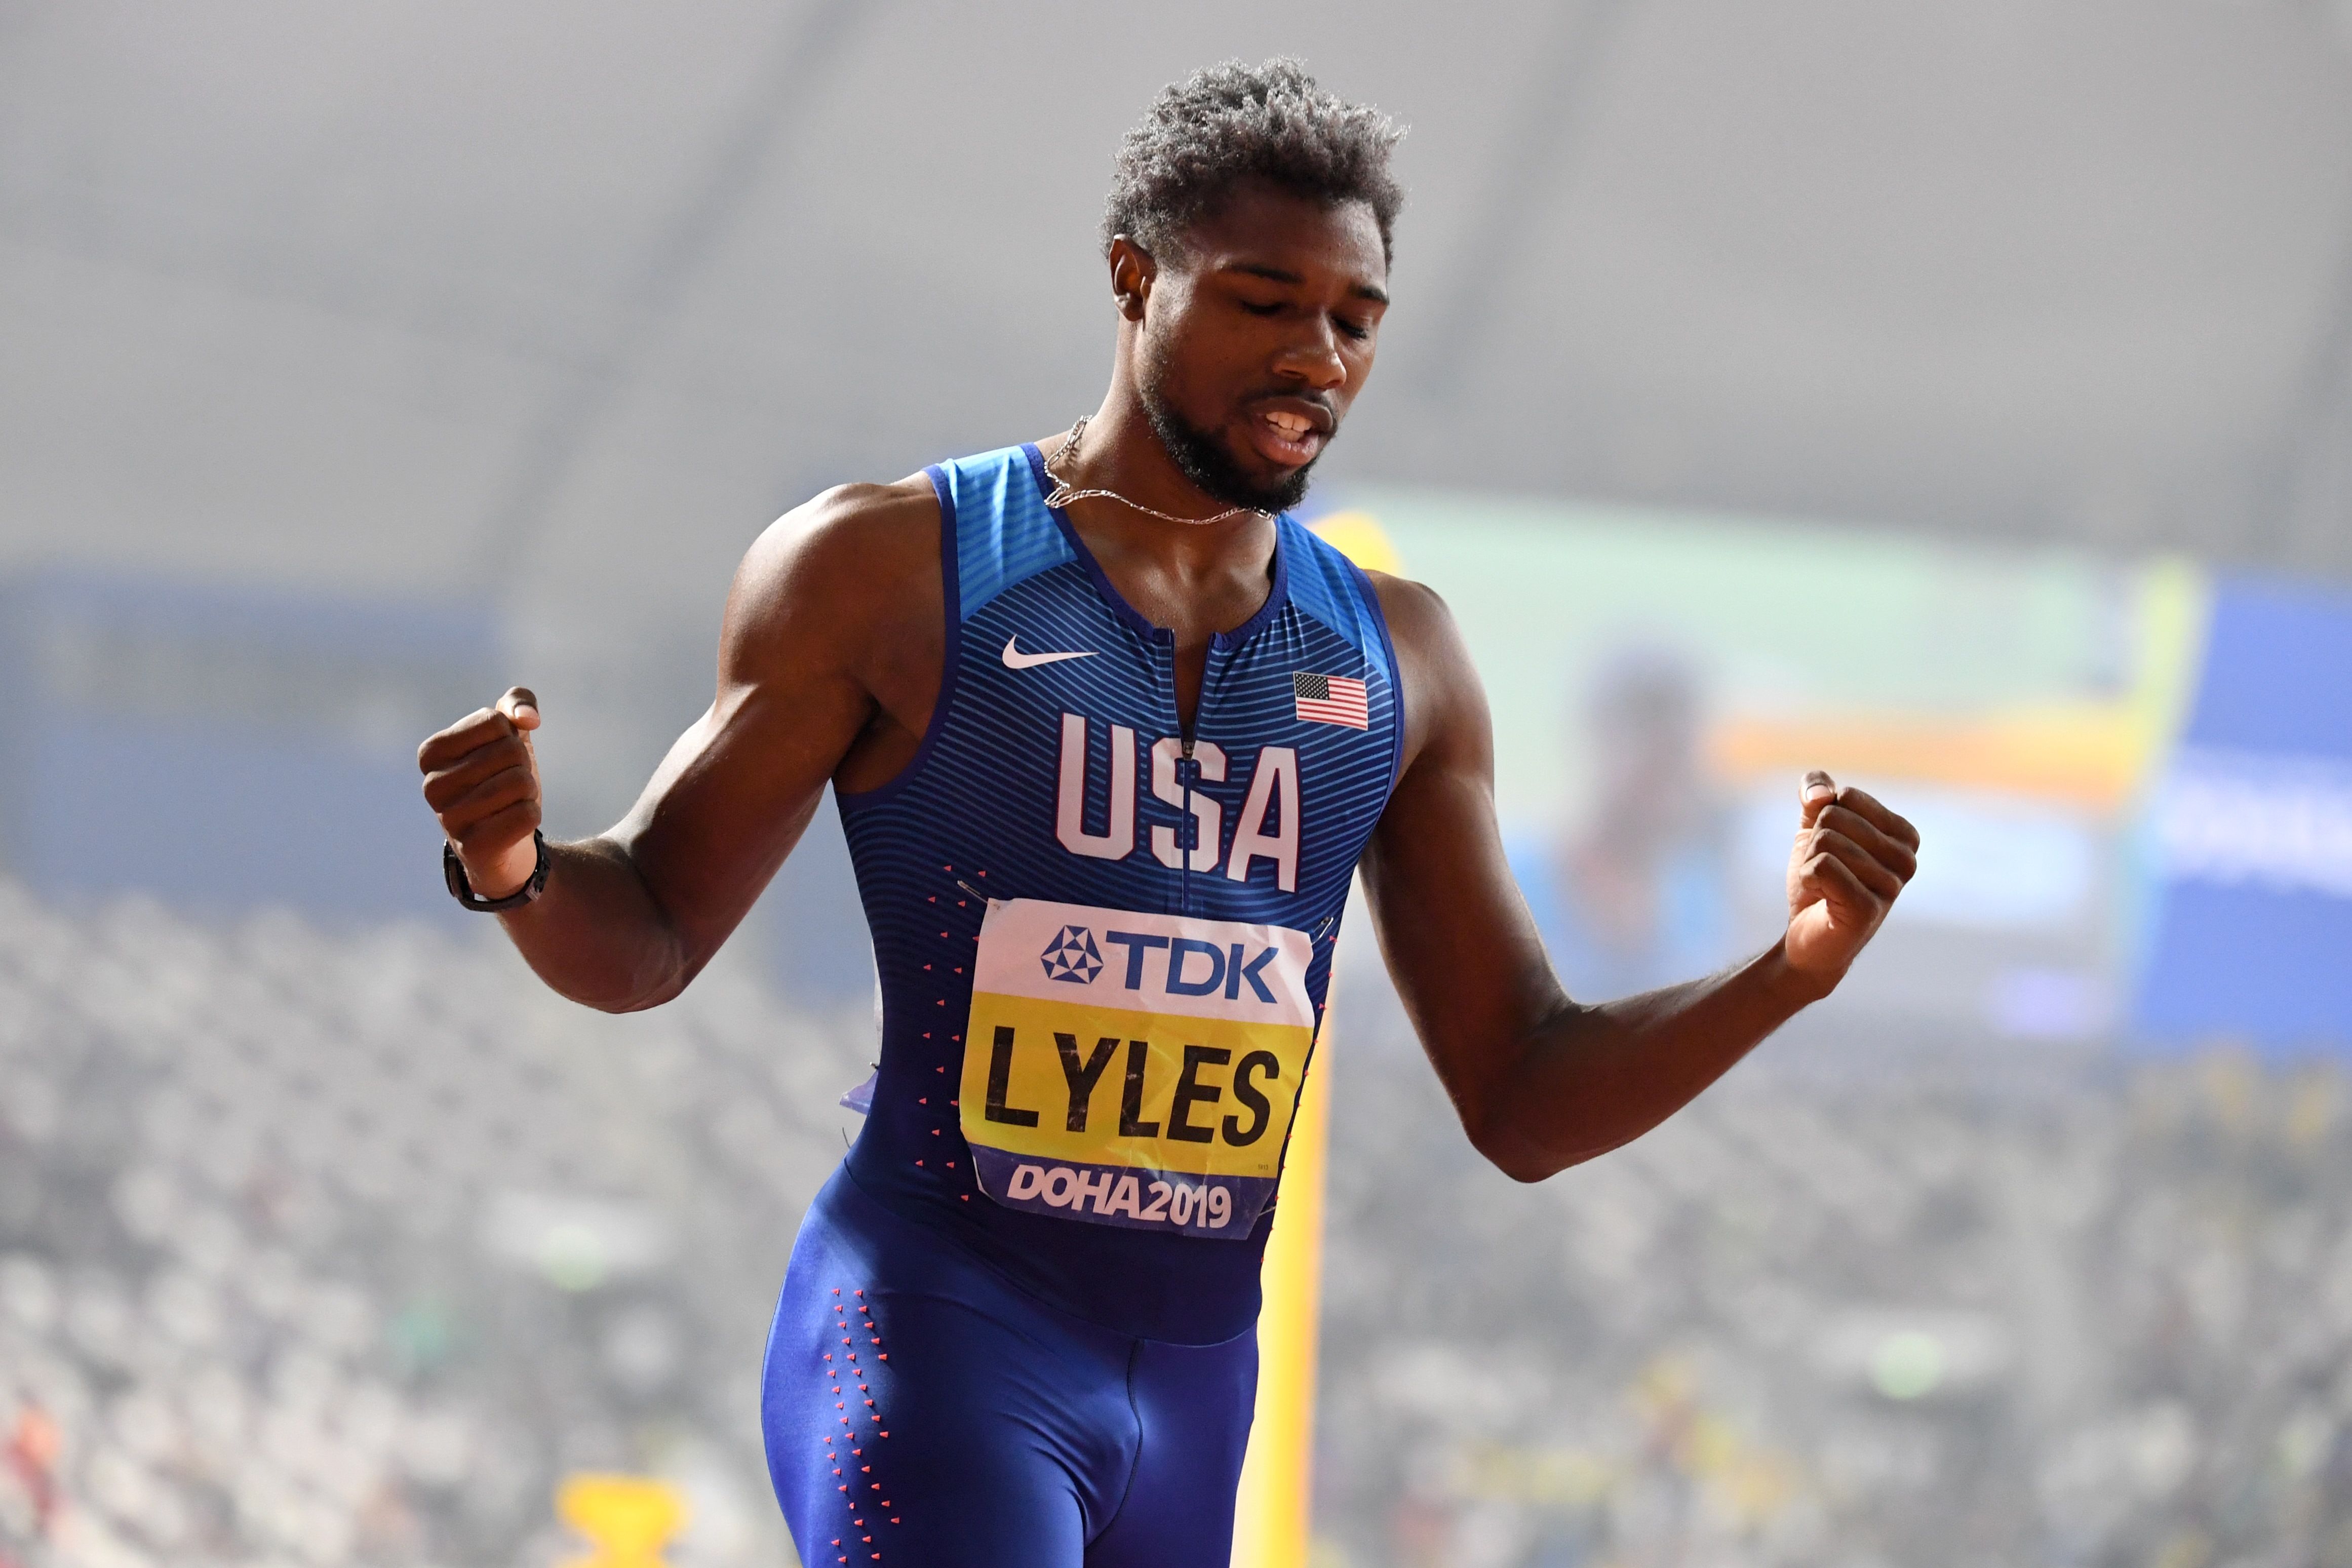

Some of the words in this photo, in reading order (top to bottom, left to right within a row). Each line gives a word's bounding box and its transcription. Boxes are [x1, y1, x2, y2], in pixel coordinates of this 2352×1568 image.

[1056, 712, 1300, 893] USA
[1106, 930, 1279, 1004] TDK
[985, 1025, 1280, 1147] LYLES
[1007, 1164, 1232, 1229] DOHA2019
